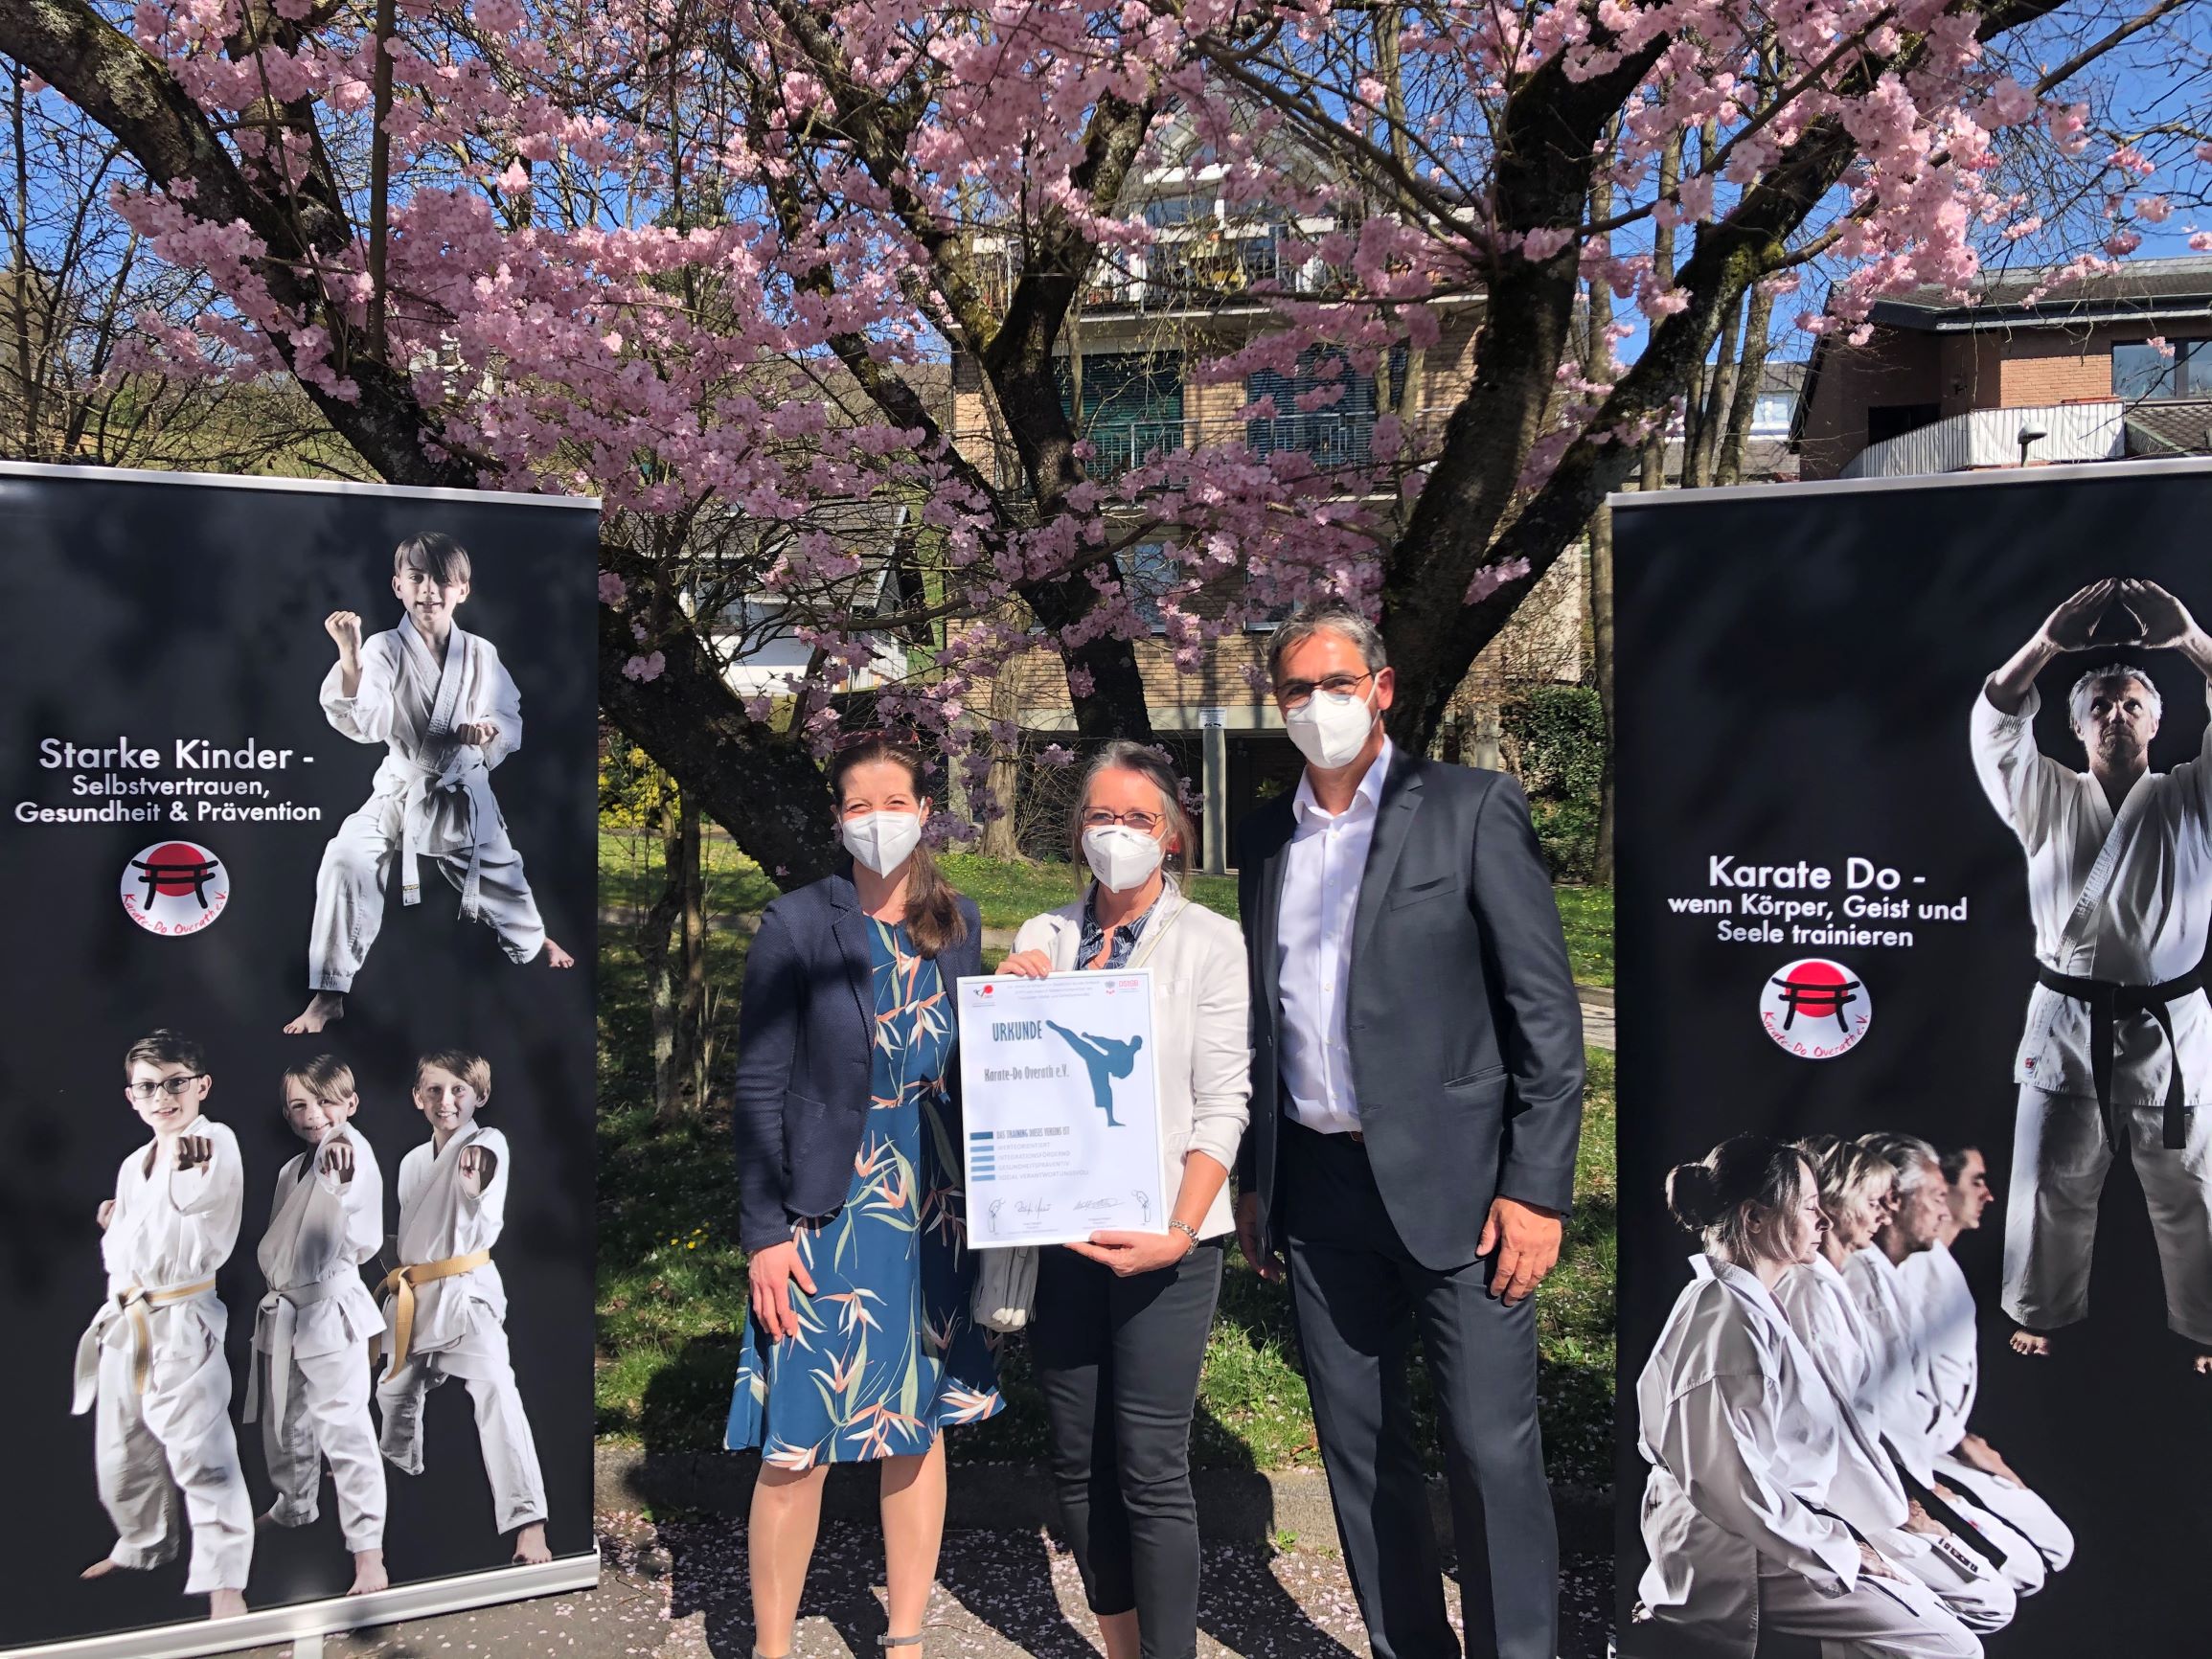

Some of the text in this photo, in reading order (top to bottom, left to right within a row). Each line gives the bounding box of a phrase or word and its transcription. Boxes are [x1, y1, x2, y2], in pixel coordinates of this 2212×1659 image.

[38, 736, 160, 770] Starke
[175, 738, 293, 770] Kinder
[72, 774, 270, 799] Selbstvertrauen,
[14, 800, 321, 823] Gesundheit & Prävention
[1709, 855, 1832, 889] Karate
[1846, 857, 1901, 891] Do
[1668, 894, 1967, 921] wenn Körper, Geist und
[1717, 920, 1913, 946] Seele trainieren
[992, 1020, 1042, 1041] URKUNDE
[985, 1068, 1022, 1082] Karate-Do
[1025, 1065, 1054, 1079] Overath
